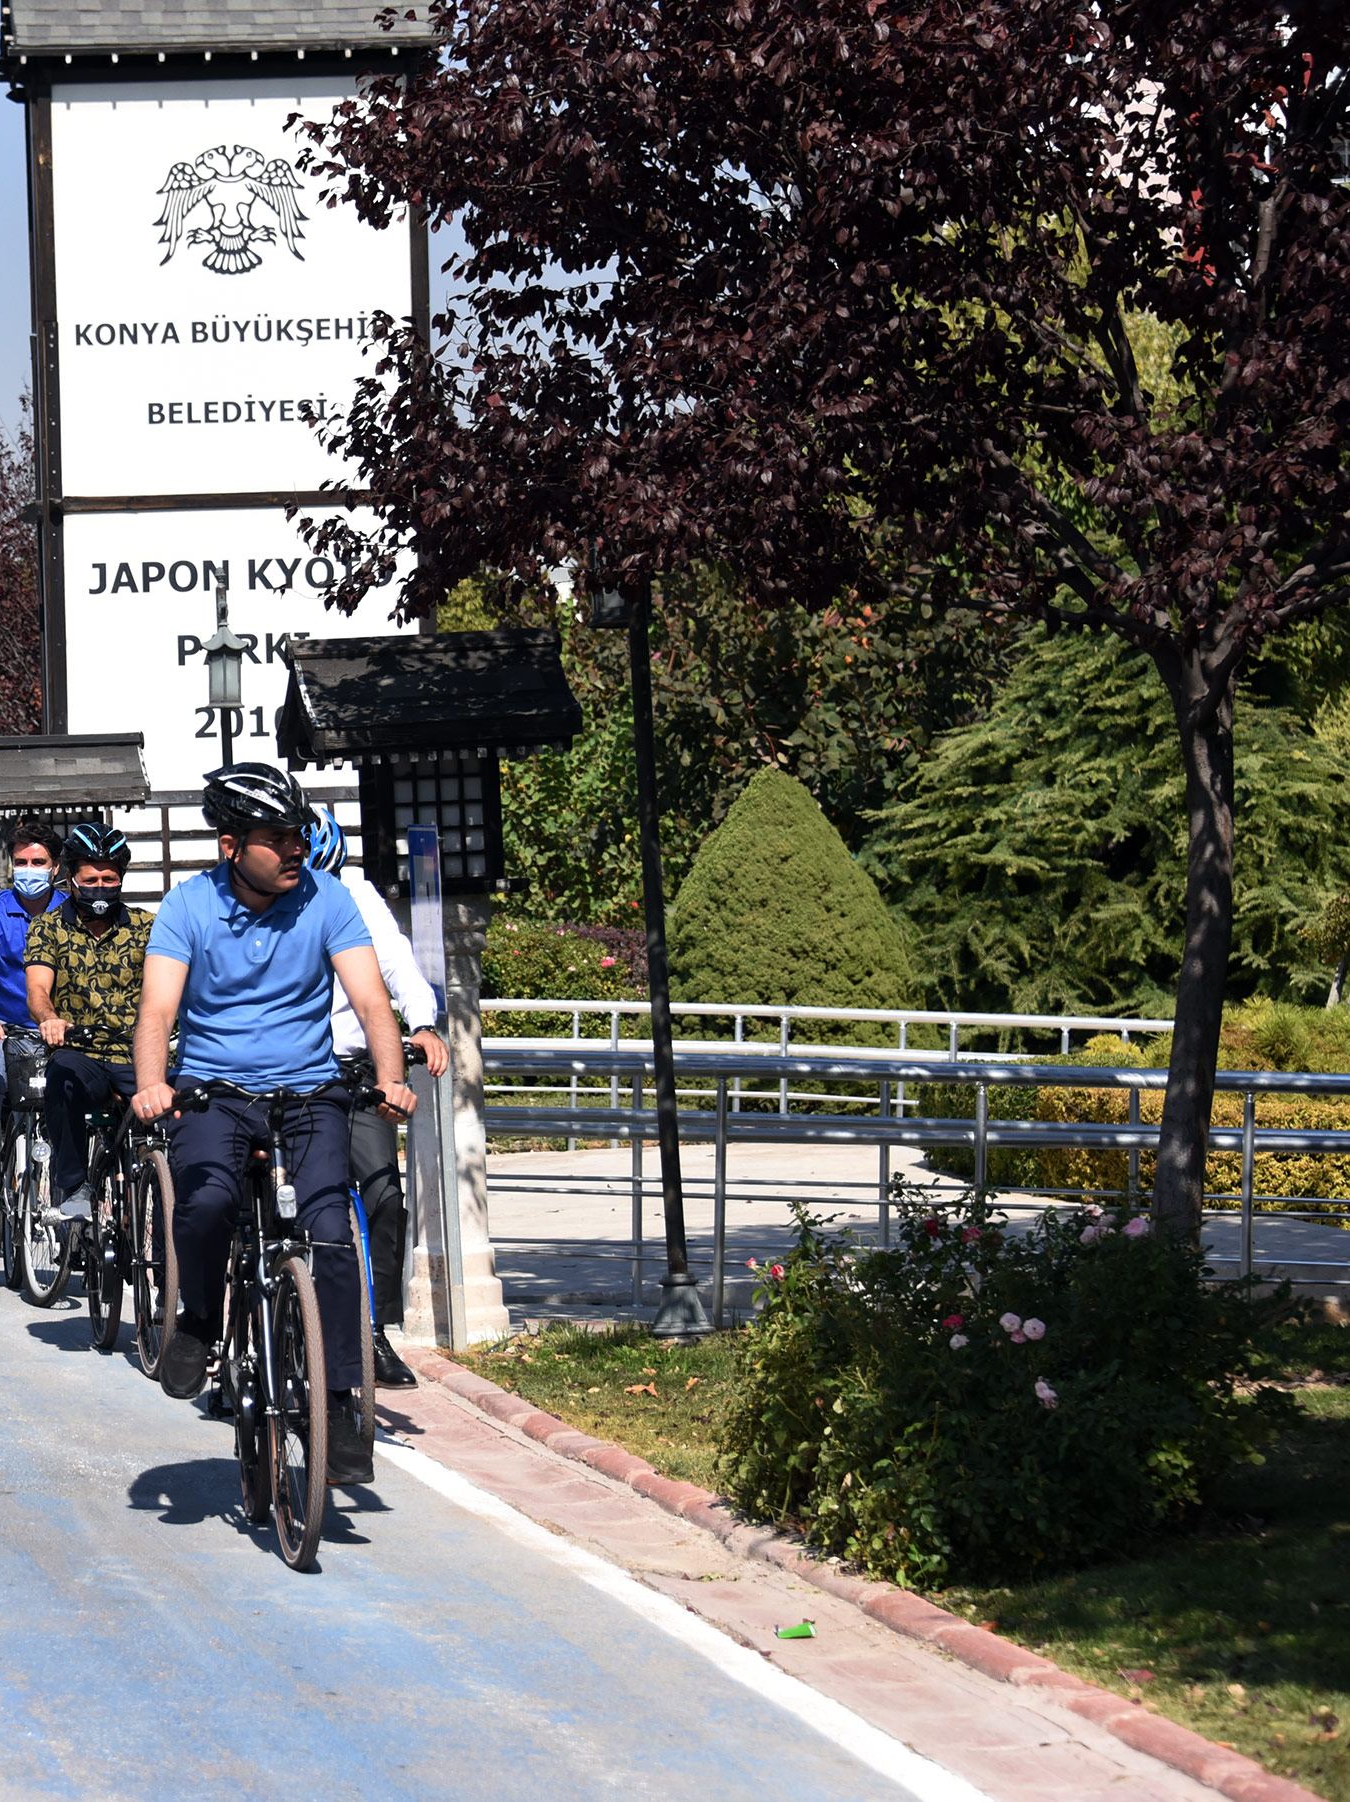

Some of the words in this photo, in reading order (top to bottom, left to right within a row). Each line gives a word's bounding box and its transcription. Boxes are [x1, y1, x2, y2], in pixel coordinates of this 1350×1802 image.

[75, 322, 180, 346] KONYA
[191, 310, 384, 347] BÜYÜKŞEHİ
[88, 559, 230, 595] JAPON
[177, 632, 310, 666] PRK
[194, 705, 285, 739] 201
